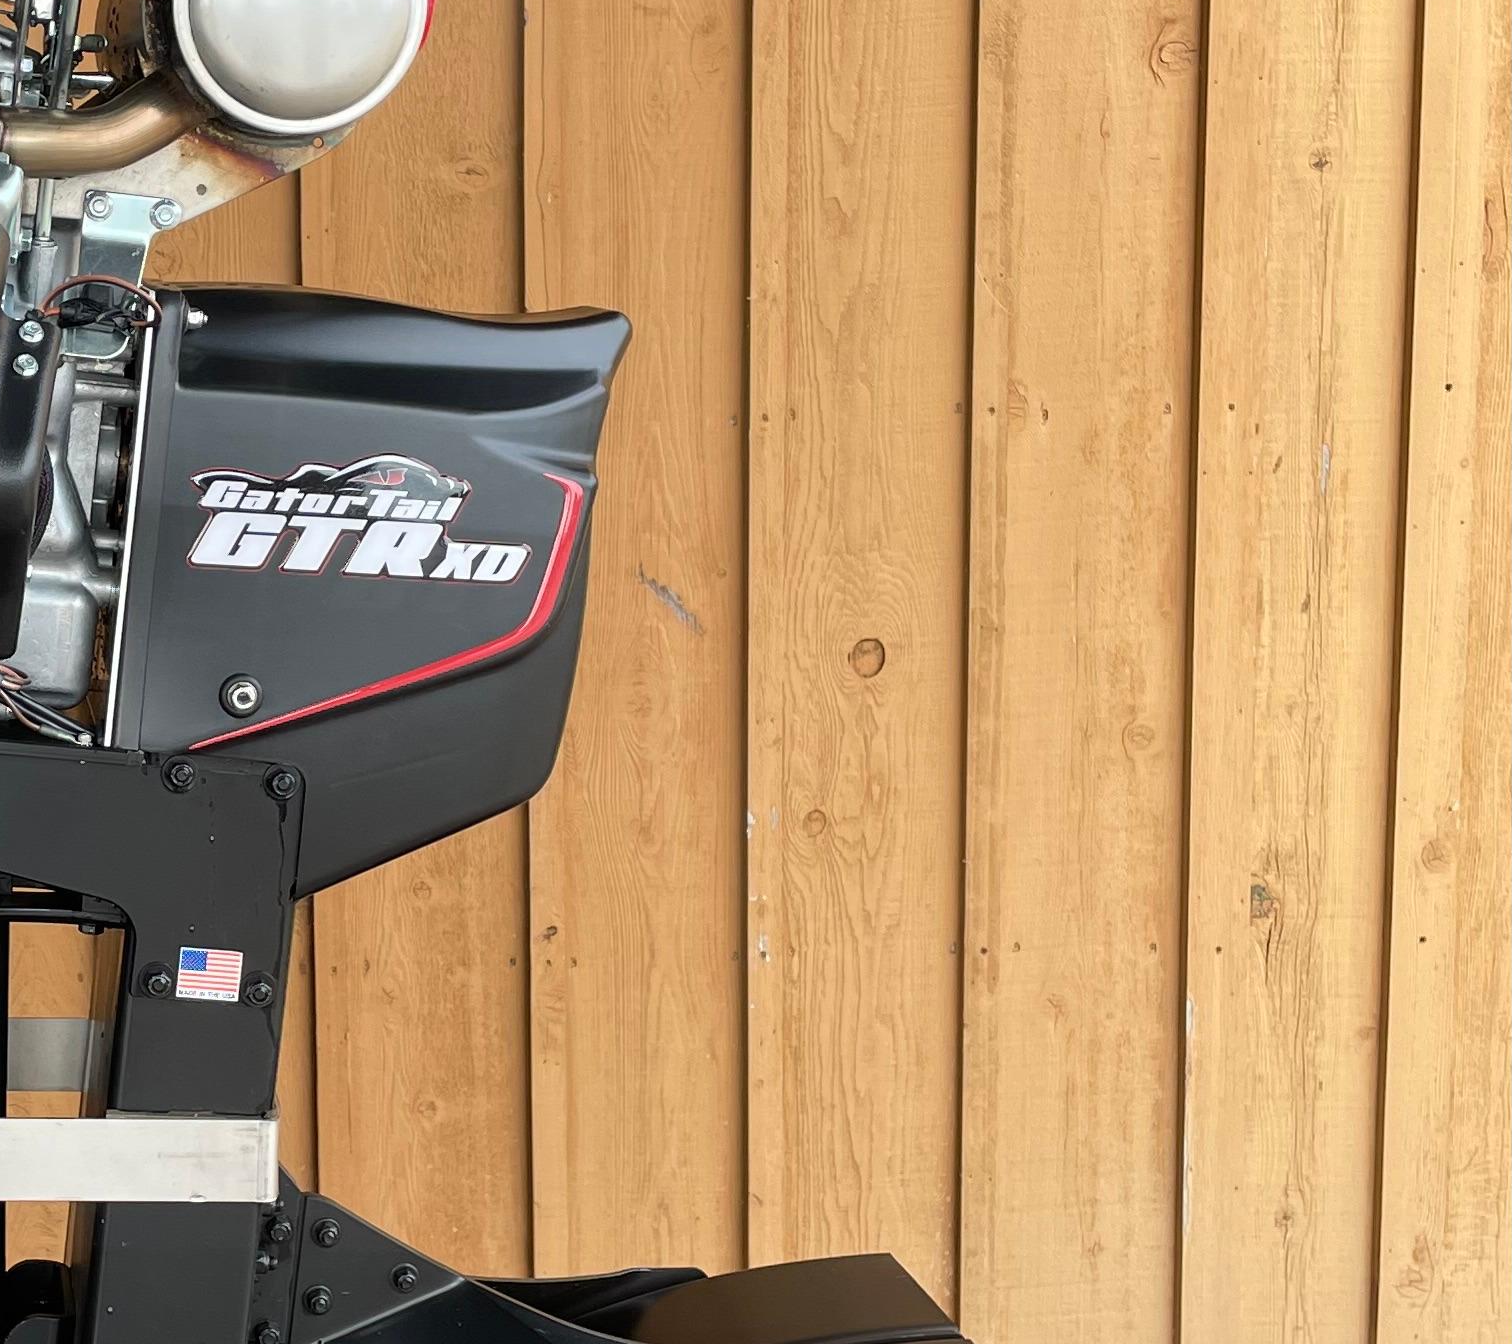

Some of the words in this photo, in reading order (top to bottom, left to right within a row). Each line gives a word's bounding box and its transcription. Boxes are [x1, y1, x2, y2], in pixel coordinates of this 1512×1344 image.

[200, 479, 465, 521] GatorTail
[189, 511, 444, 578] GTR
[429, 542, 531, 582] XD
